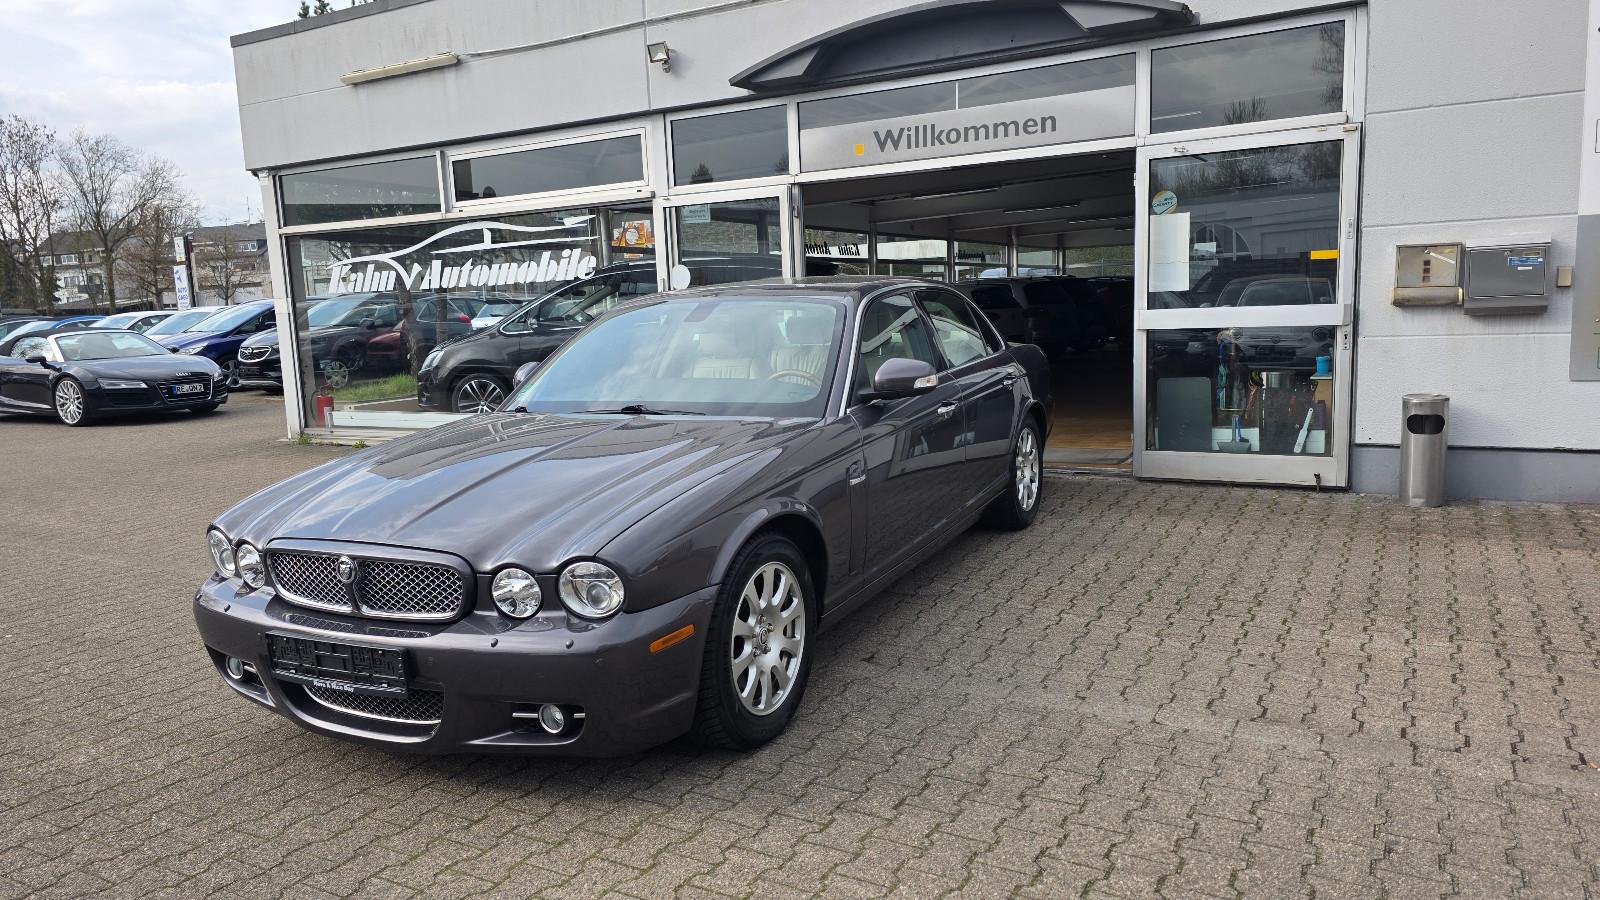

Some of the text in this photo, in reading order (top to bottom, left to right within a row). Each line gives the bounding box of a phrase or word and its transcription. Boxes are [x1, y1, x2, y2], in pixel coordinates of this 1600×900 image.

[873, 115, 1057, 152] Willkommen
[328, 248, 597, 294] Kahn Automobile
